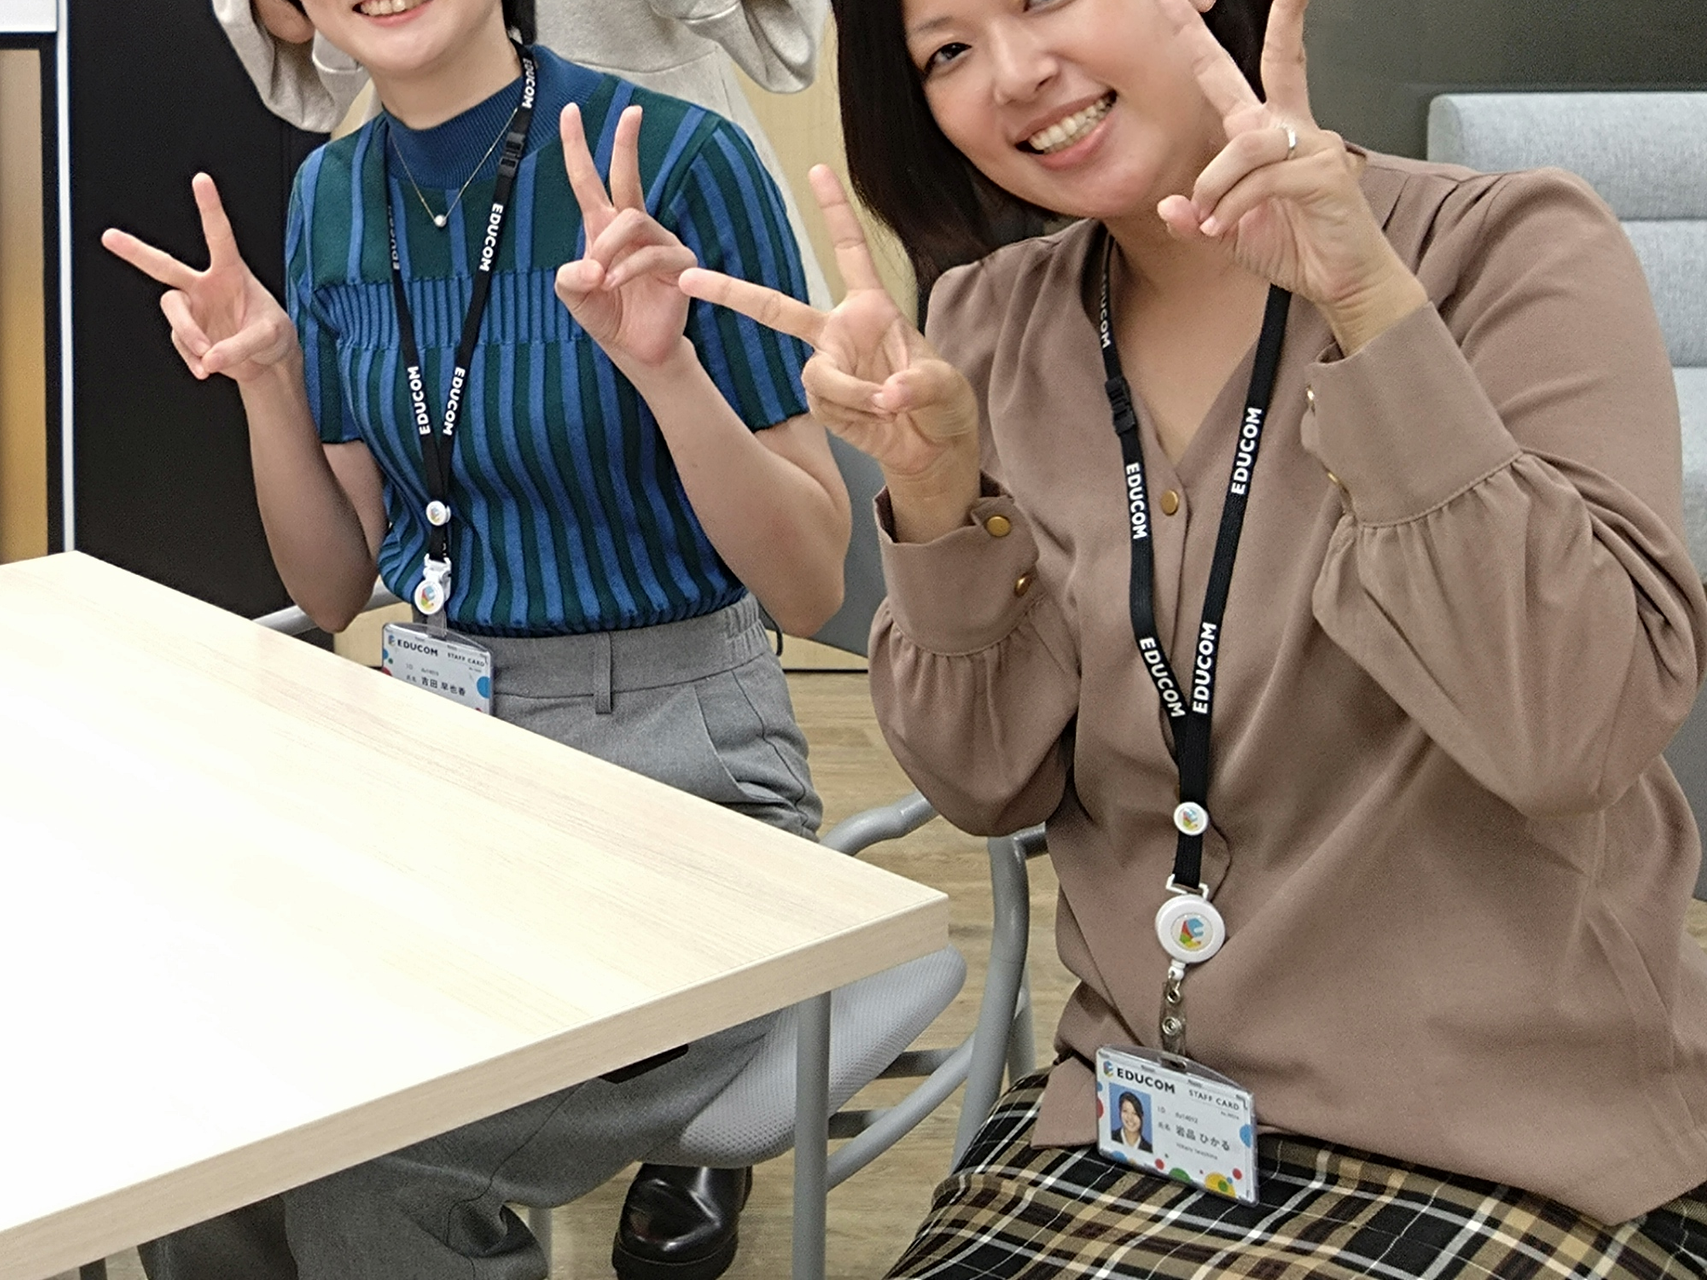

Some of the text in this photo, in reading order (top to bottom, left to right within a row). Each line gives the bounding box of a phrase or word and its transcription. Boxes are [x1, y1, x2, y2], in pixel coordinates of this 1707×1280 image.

[522, 57, 535, 109] EDUCOM
[479, 203, 504, 272] EDUCOM
[407, 366, 431, 435] EDUCOM
[442, 366, 466, 436] EDUCOM
[1230, 406, 1263, 495] EDUCOM
[1125, 461, 1148, 540] EDUCOM
[397, 639, 438, 657] EDUCOM
[447, 652, 485, 667] STAFF CARD
[1138, 636, 1186, 718] EDUCOM
[1191, 621, 1217, 714] EDUCOM
[1117, 1067, 1176, 1094] EDUCOM
[1189, 1089, 1240, 1111] STAFF CARD
[1199, 1133, 1230, 1151] ひかる
